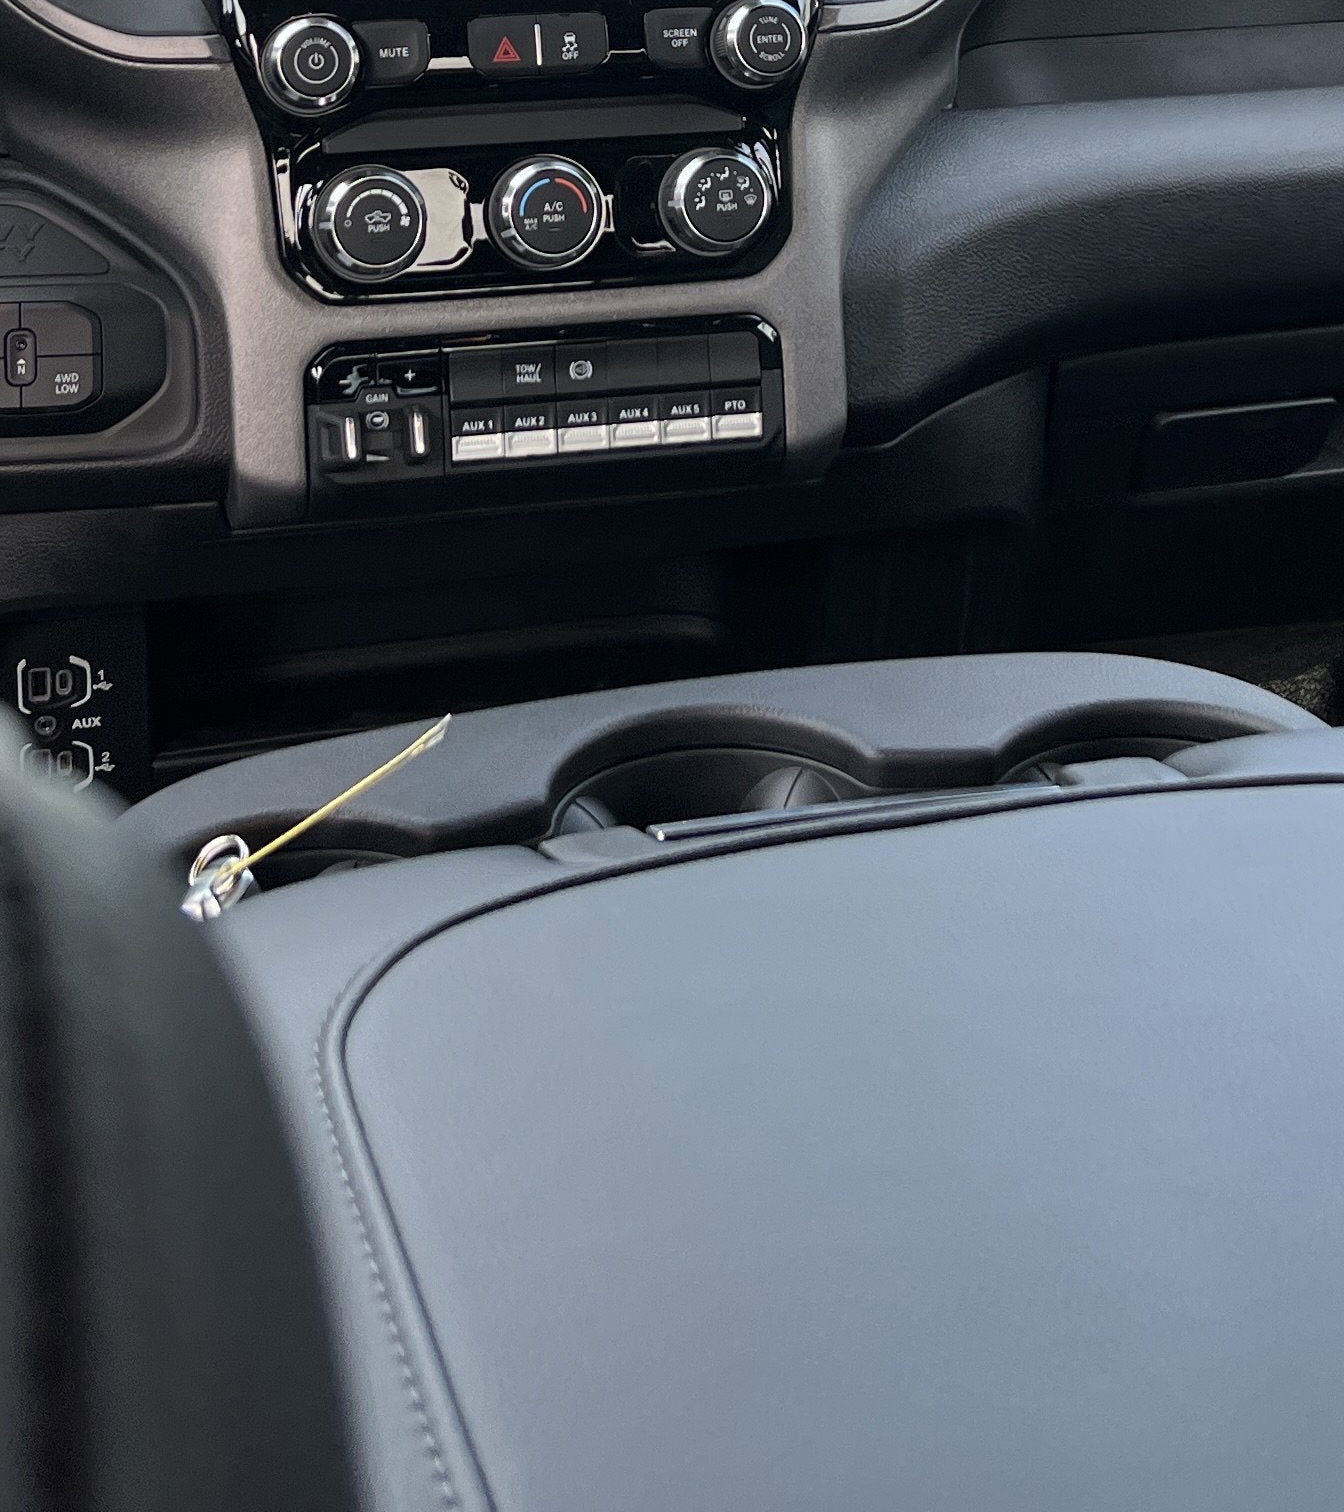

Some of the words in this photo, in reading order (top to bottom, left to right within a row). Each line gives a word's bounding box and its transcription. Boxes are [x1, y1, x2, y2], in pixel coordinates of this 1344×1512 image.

[759, 16, 778, 25] TUNE
[663, 28, 698, 38] SCREEN
[301, 37, 332, 48] VOLUME
[671, 38, 689, 48] OFF
[757, 34, 784, 44] ENTER
[379, 47, 409, 58] MUTE
[561, 51, 579, 60] OFF
[759, 51, 785, 61] SCROLL
[544, 201, 563, 211] A/C
[716, 202, 737, 211] PUSH
[543, 214, 565, 223] PUSH
[367, 224, 390, 233] PUSH
[17, 365, 26, 376] N
[515, 363, 542, 374] TOW/
[55, 372, 80, 384] 4WD
[516, 373, 542, 383] HAUL
[55, 383, 80, 395] LOW
[365, 393, 389, 403] GAIN
[670, 405, 693, 416] AUX
[693, 404, 700, 414] 5
[724, 399, 746, 411] PTO
[567, 413, 590, 423] AUX
[591, 412, 598, 422] 3
[619, 409, 641, 419] AUX
[641, 408, 649, 418] 4
[462, 420, 485, 431] AUX
[488, 419, 494, 429] 1
[514, 417, 537, 427] AUX
[538, 416, 545, 426] 2
[97, 669, 105, 680] 1
[71, 715, 102, 730] AUX
[101, 752, 110, 762] 2
